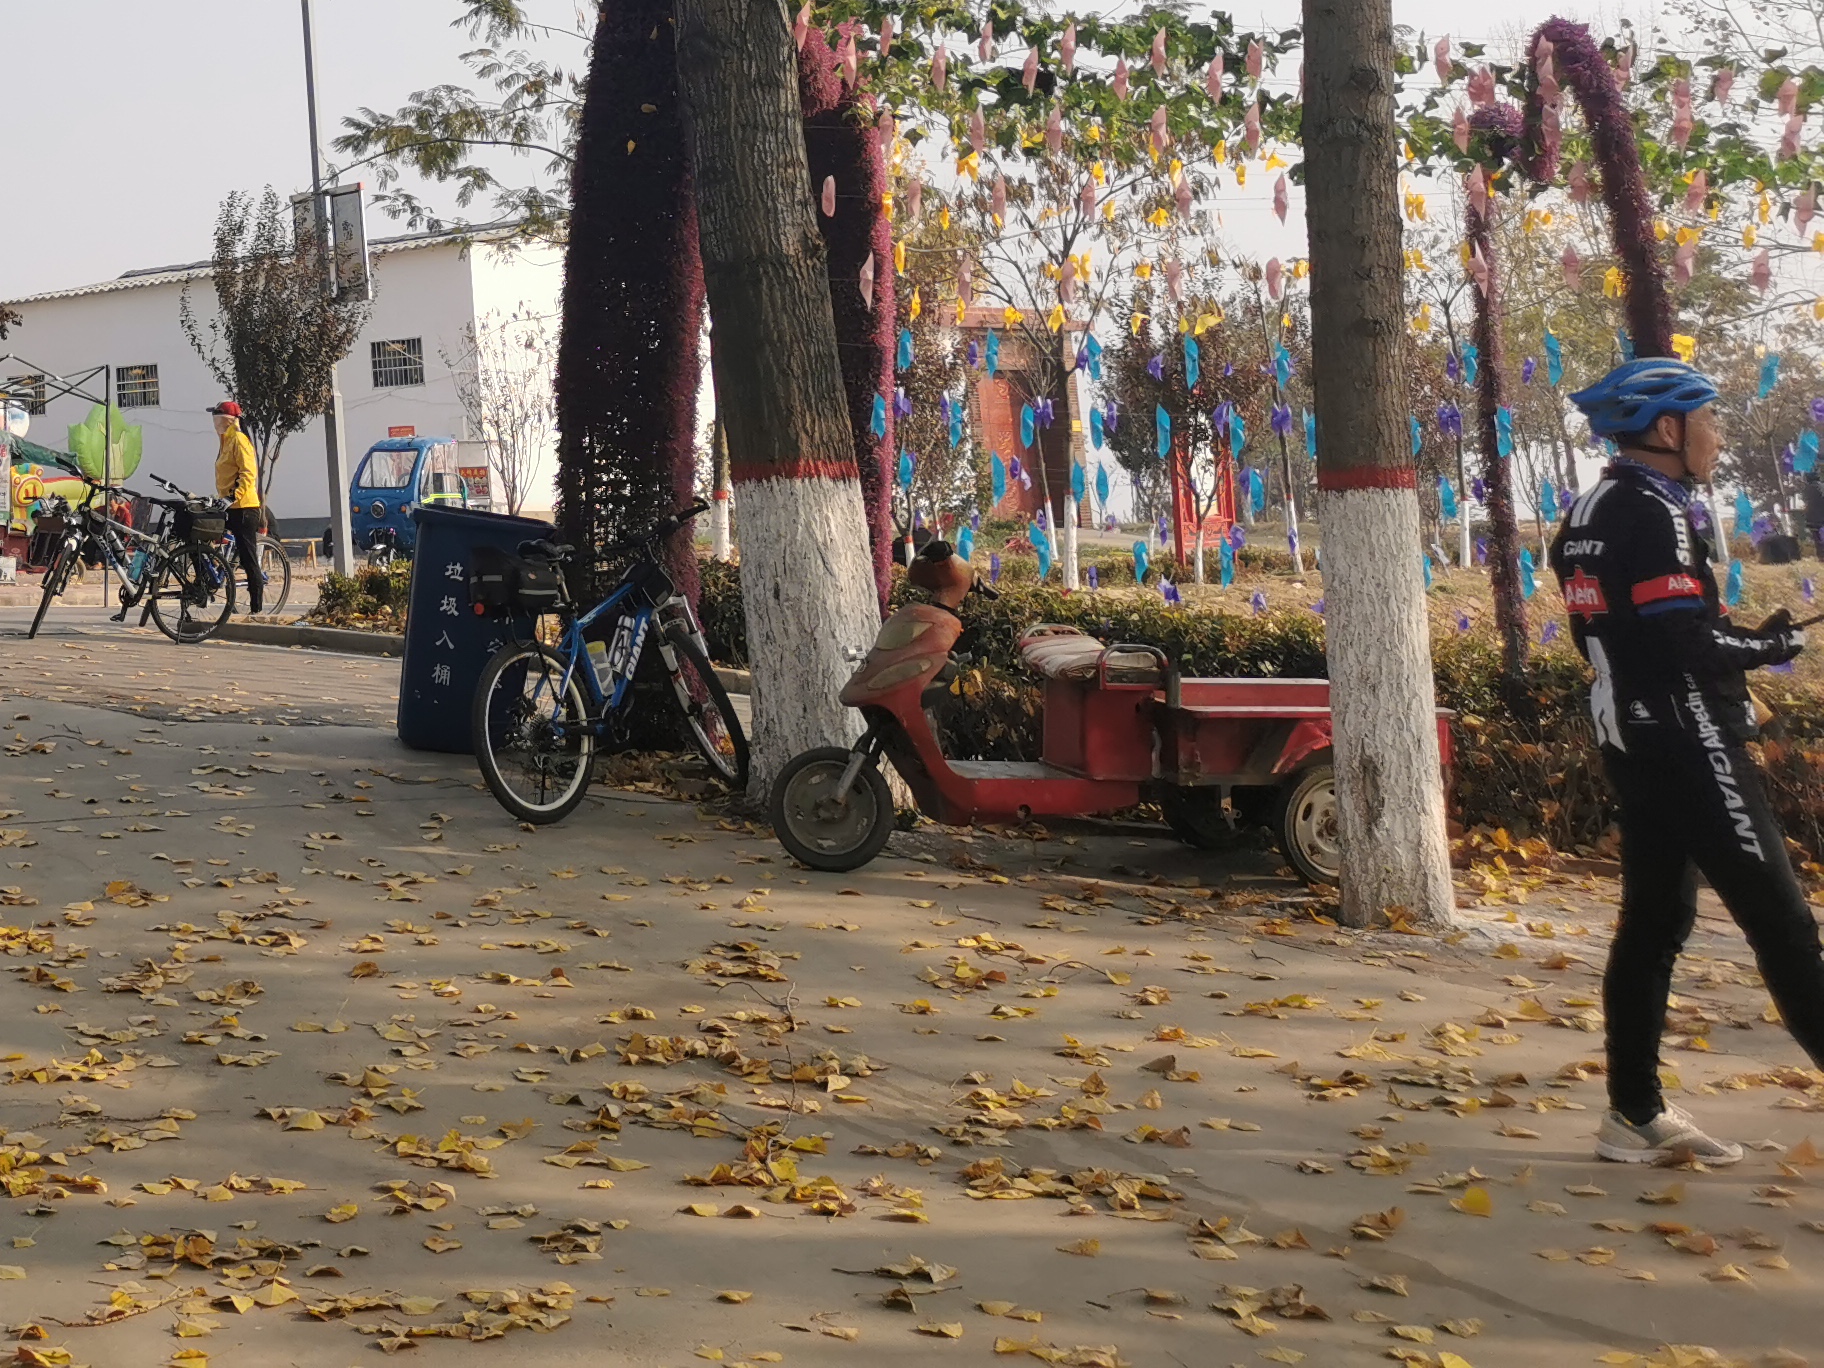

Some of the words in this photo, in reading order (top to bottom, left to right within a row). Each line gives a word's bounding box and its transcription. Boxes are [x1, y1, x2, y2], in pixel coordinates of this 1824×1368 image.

[431, 562, 464, 687] 垃圾入桶
[625, 617, 649, 681] GIANT
[1684, 691, 1726, 749] Alpecin
[1708, 750, 1766, 862] GIANT
